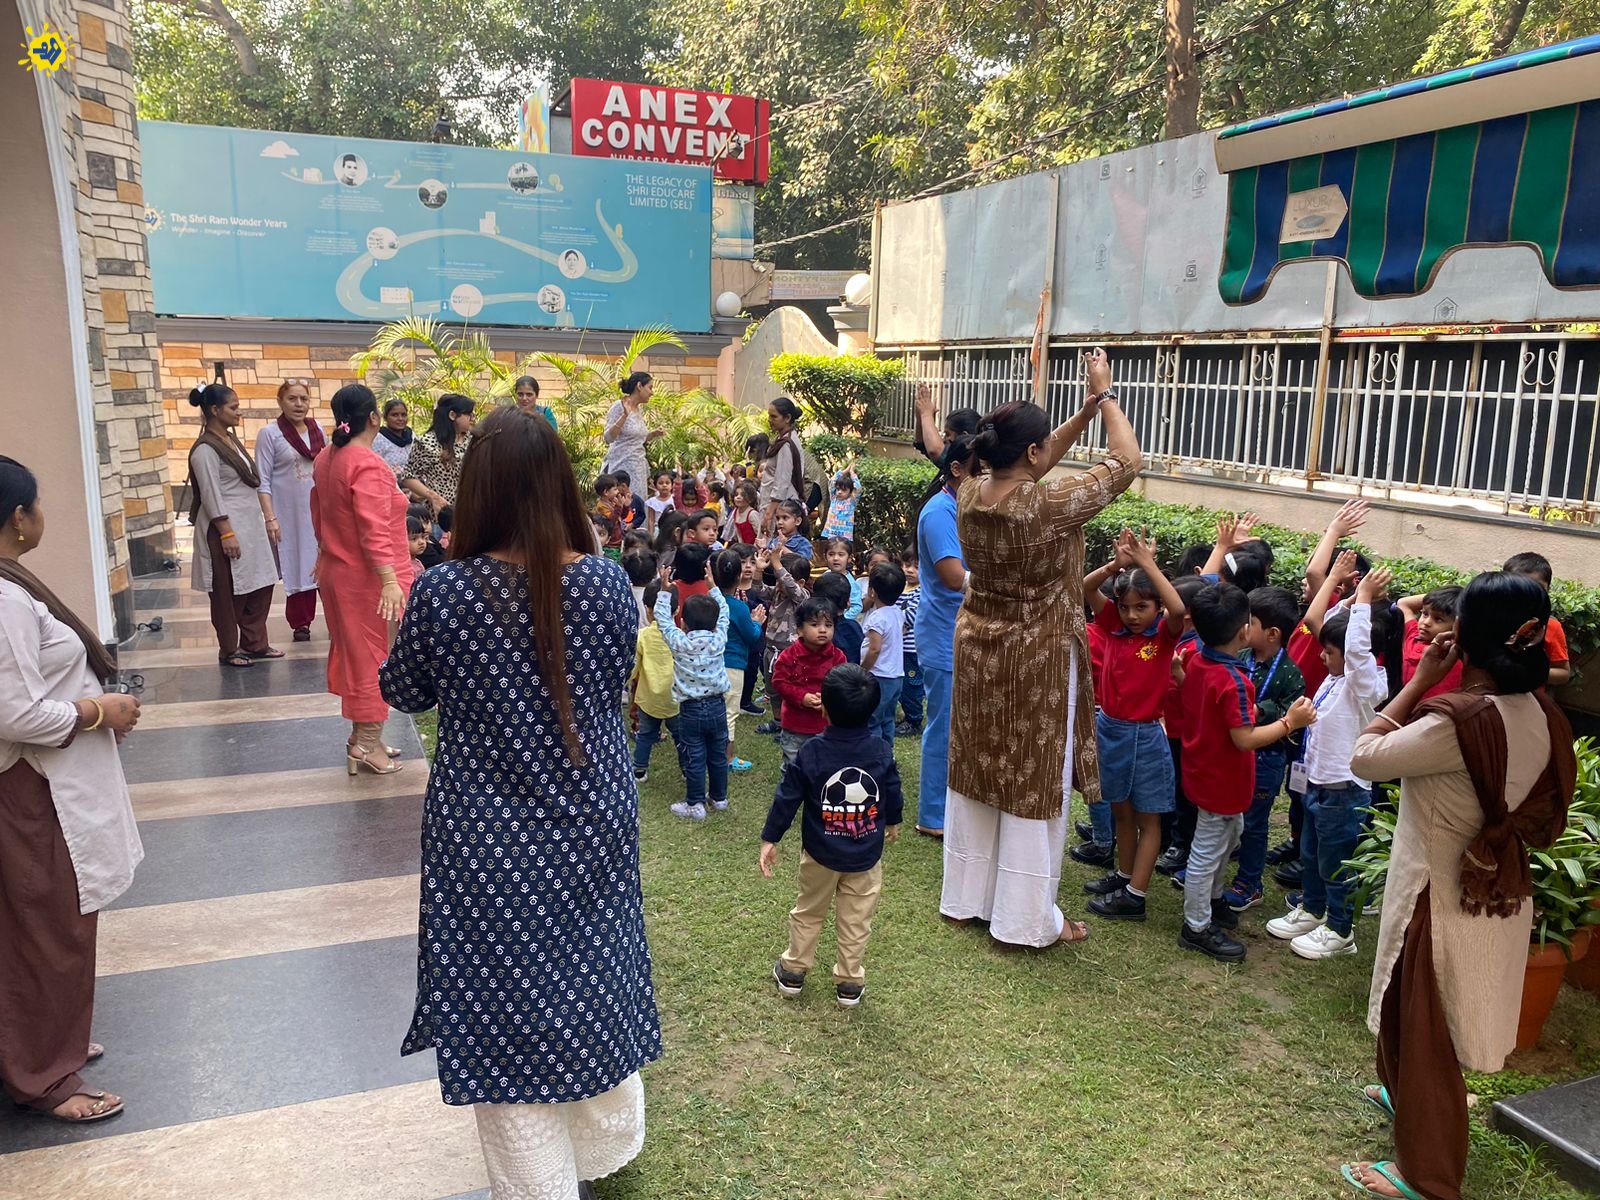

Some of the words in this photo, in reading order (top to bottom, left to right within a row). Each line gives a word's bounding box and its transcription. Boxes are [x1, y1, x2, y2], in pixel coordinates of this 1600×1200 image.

[601, 85, 733, 128] ANEX
[625, 174, 645, 185] THE
[646, 175, 682, 188] LEGACY
[684, 178, 697, 189] OF
[626, 185, 649, 196] SHRI
[651, 187, 695, 199] EDUCARE
[717, 189, 749, 200] Island
[629, 197, 668, 208] LIMITED
[670, 199, 693, 211] (SEL)
[170, 212, 187, 223] The
[190, 214, 207, 224] Shri
[209, 215, 229, 225] Ram
[230, 216, 262, 227] Wonder
[264, 219, 287, 229] Years
